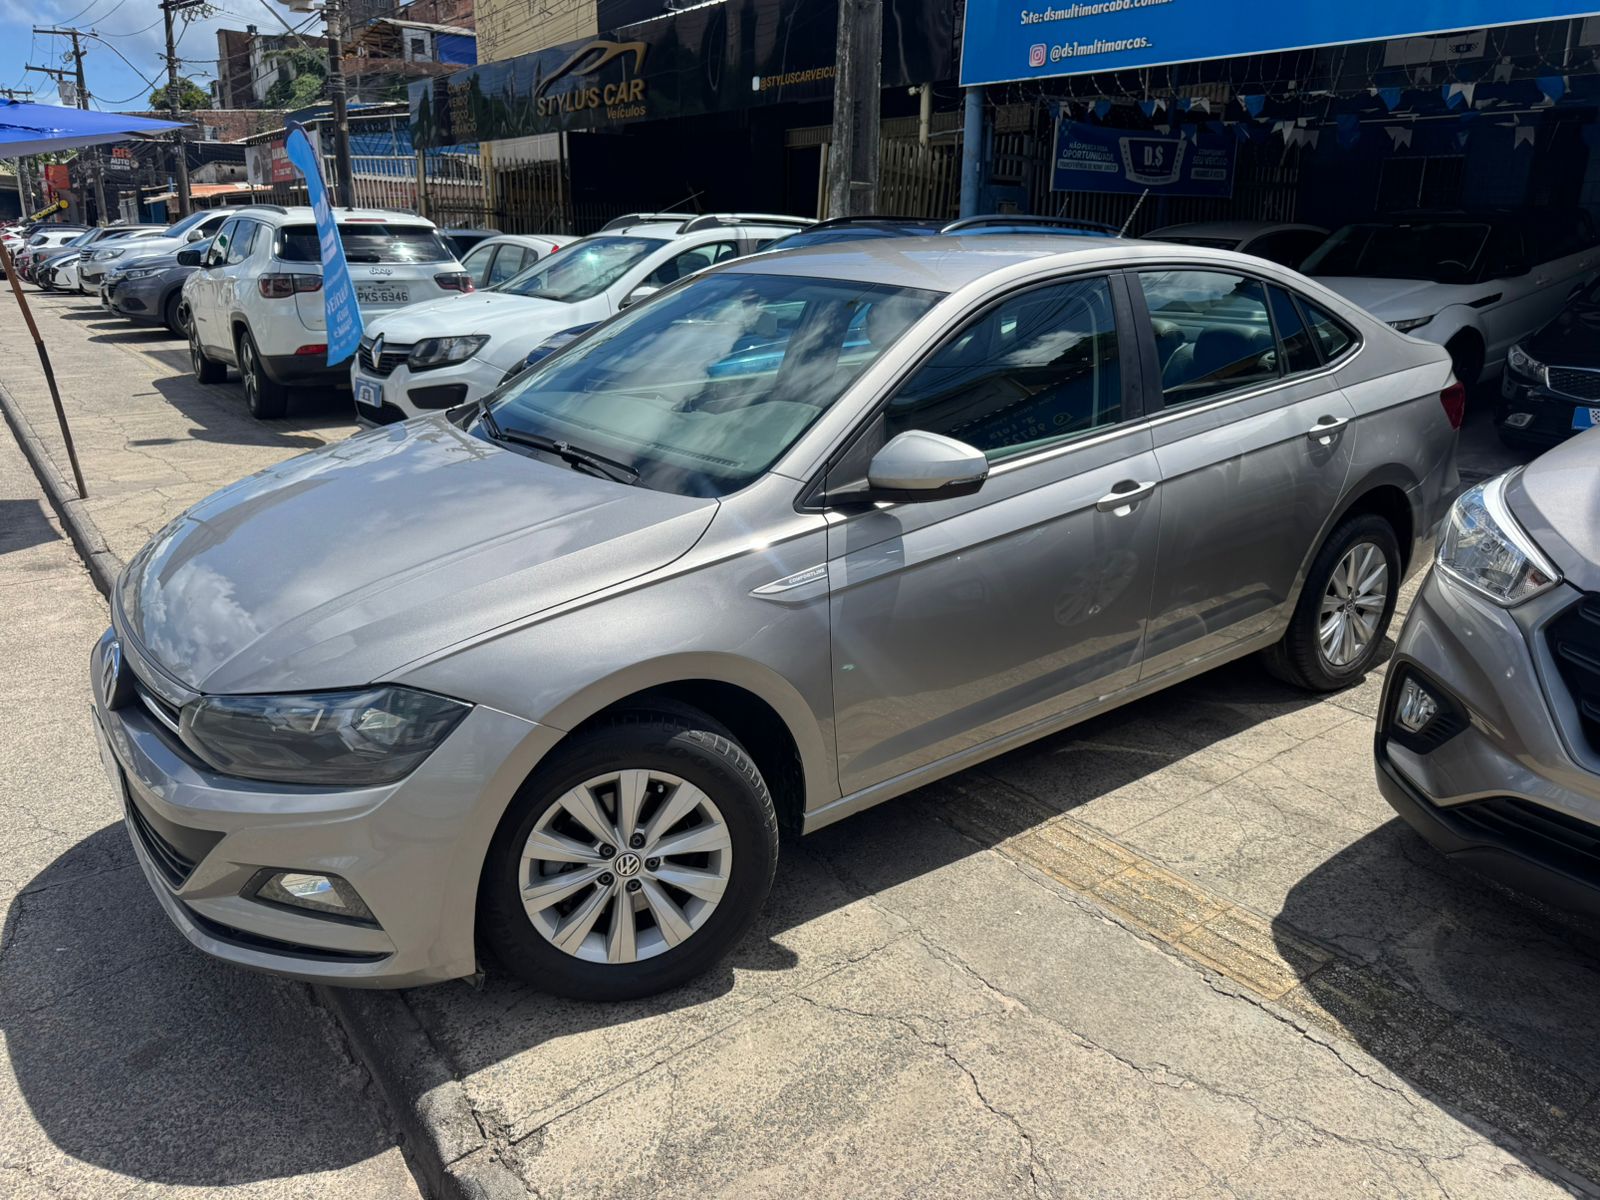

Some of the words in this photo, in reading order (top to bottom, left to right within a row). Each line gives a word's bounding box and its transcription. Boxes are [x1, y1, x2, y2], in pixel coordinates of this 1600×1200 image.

[1020, 10, 1043, 25] Site:
[760, 66, 837, 91] @STYLUSCARVEICU
[603, 79, 646, 106] CAR
[607, 103, 647, 120] Veículos
[110, 157, 130, 166] AUTO
[788, 567, 826, 584] COMFORTLINE
